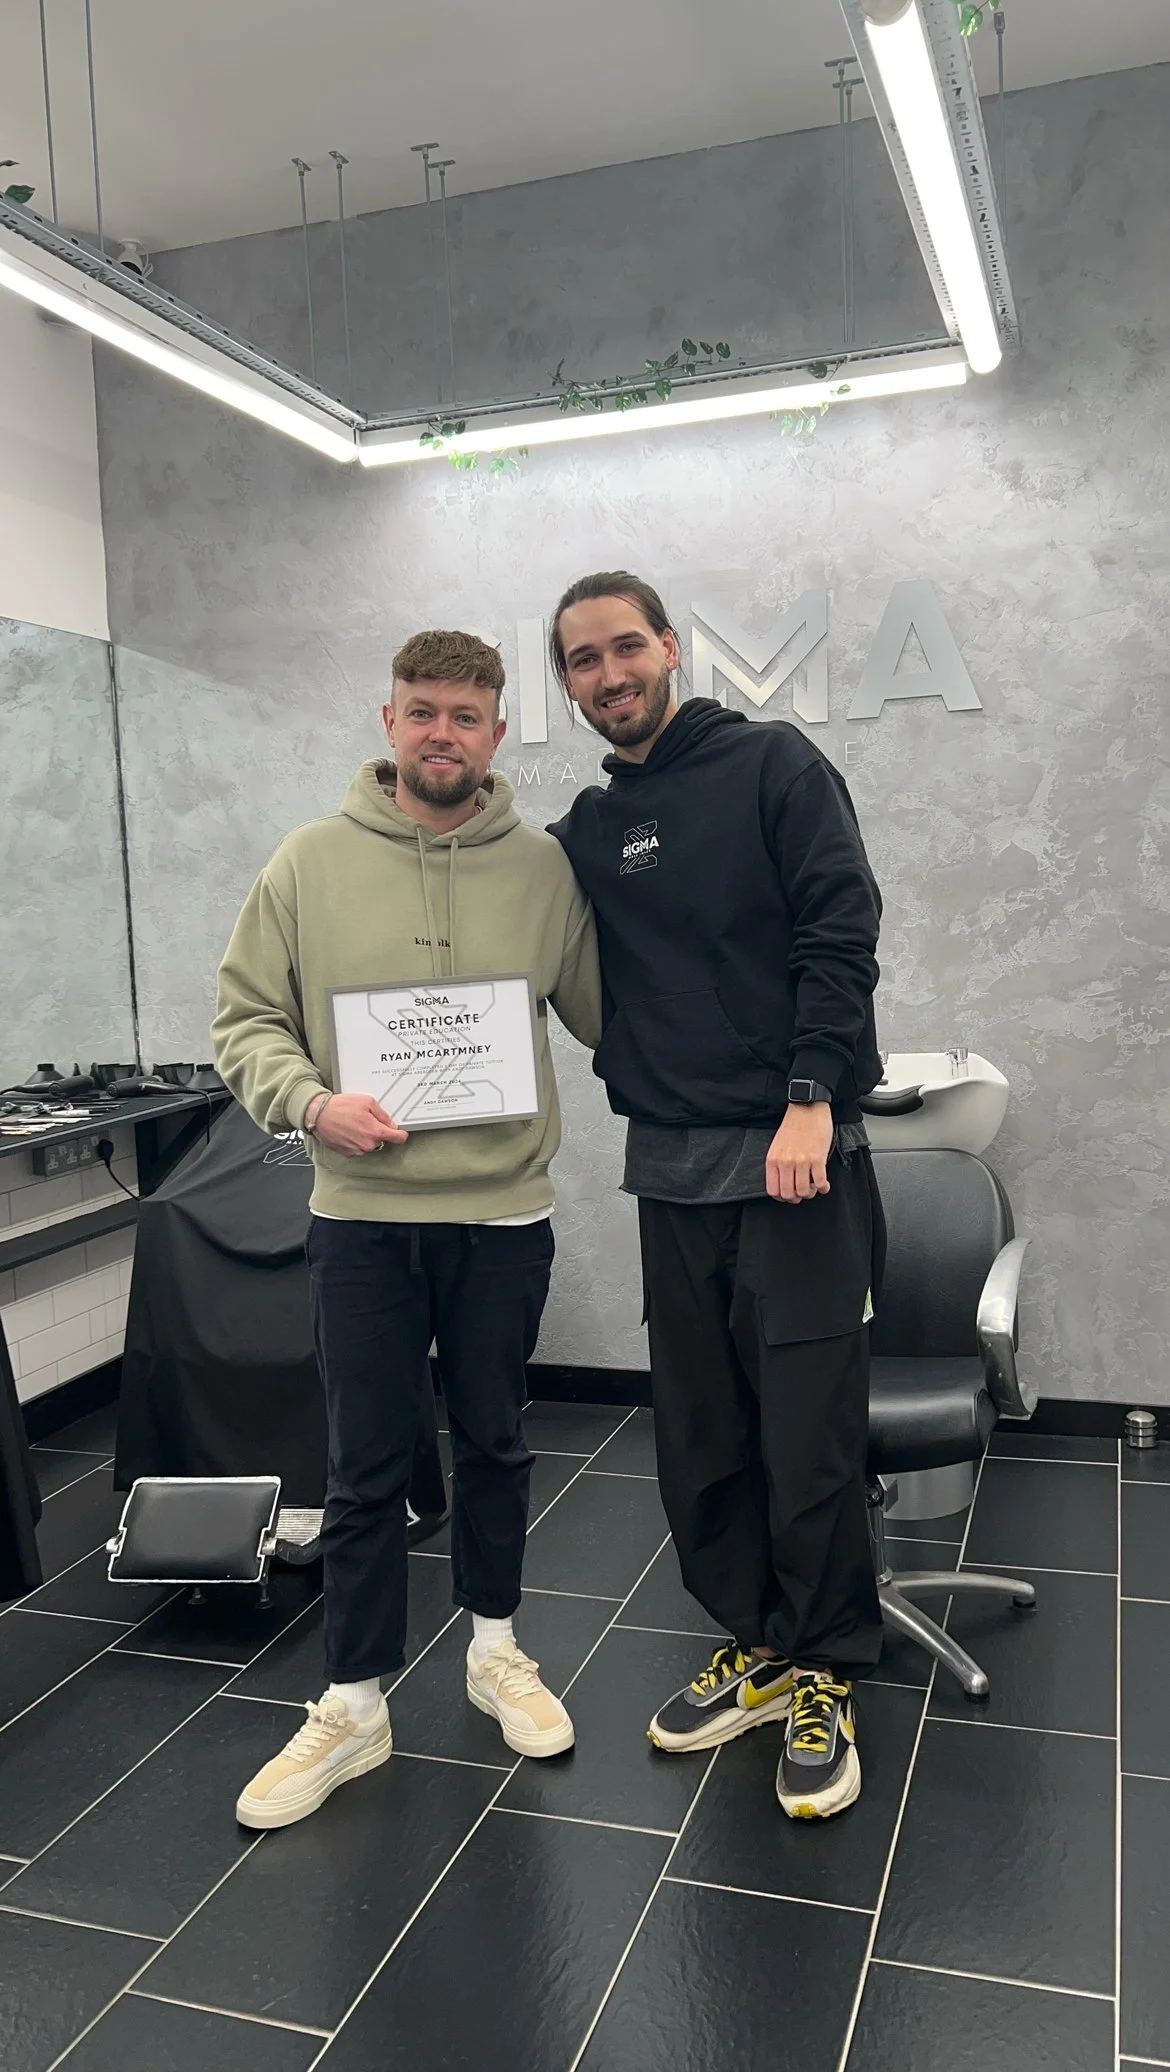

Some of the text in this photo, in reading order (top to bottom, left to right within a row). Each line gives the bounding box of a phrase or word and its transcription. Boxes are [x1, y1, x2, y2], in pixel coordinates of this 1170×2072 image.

[400, 579, 983, 745] IMA
[517, 759, 609, 787] MAL
[622, 836, 660, 859] SIGMA
[414, 937, 451, 948] kinlk
[414, 996, 450, 1007] SIGMA
[388, 1013, 480, 1031] CERTIFICATE
[398, 1026, 471, 1037] PRIVATE EDUCATION
[428, 1036, 461, 1045] CERTIFIES
[380, 1044, 492, 1062] RYAN MCARTMNEY
